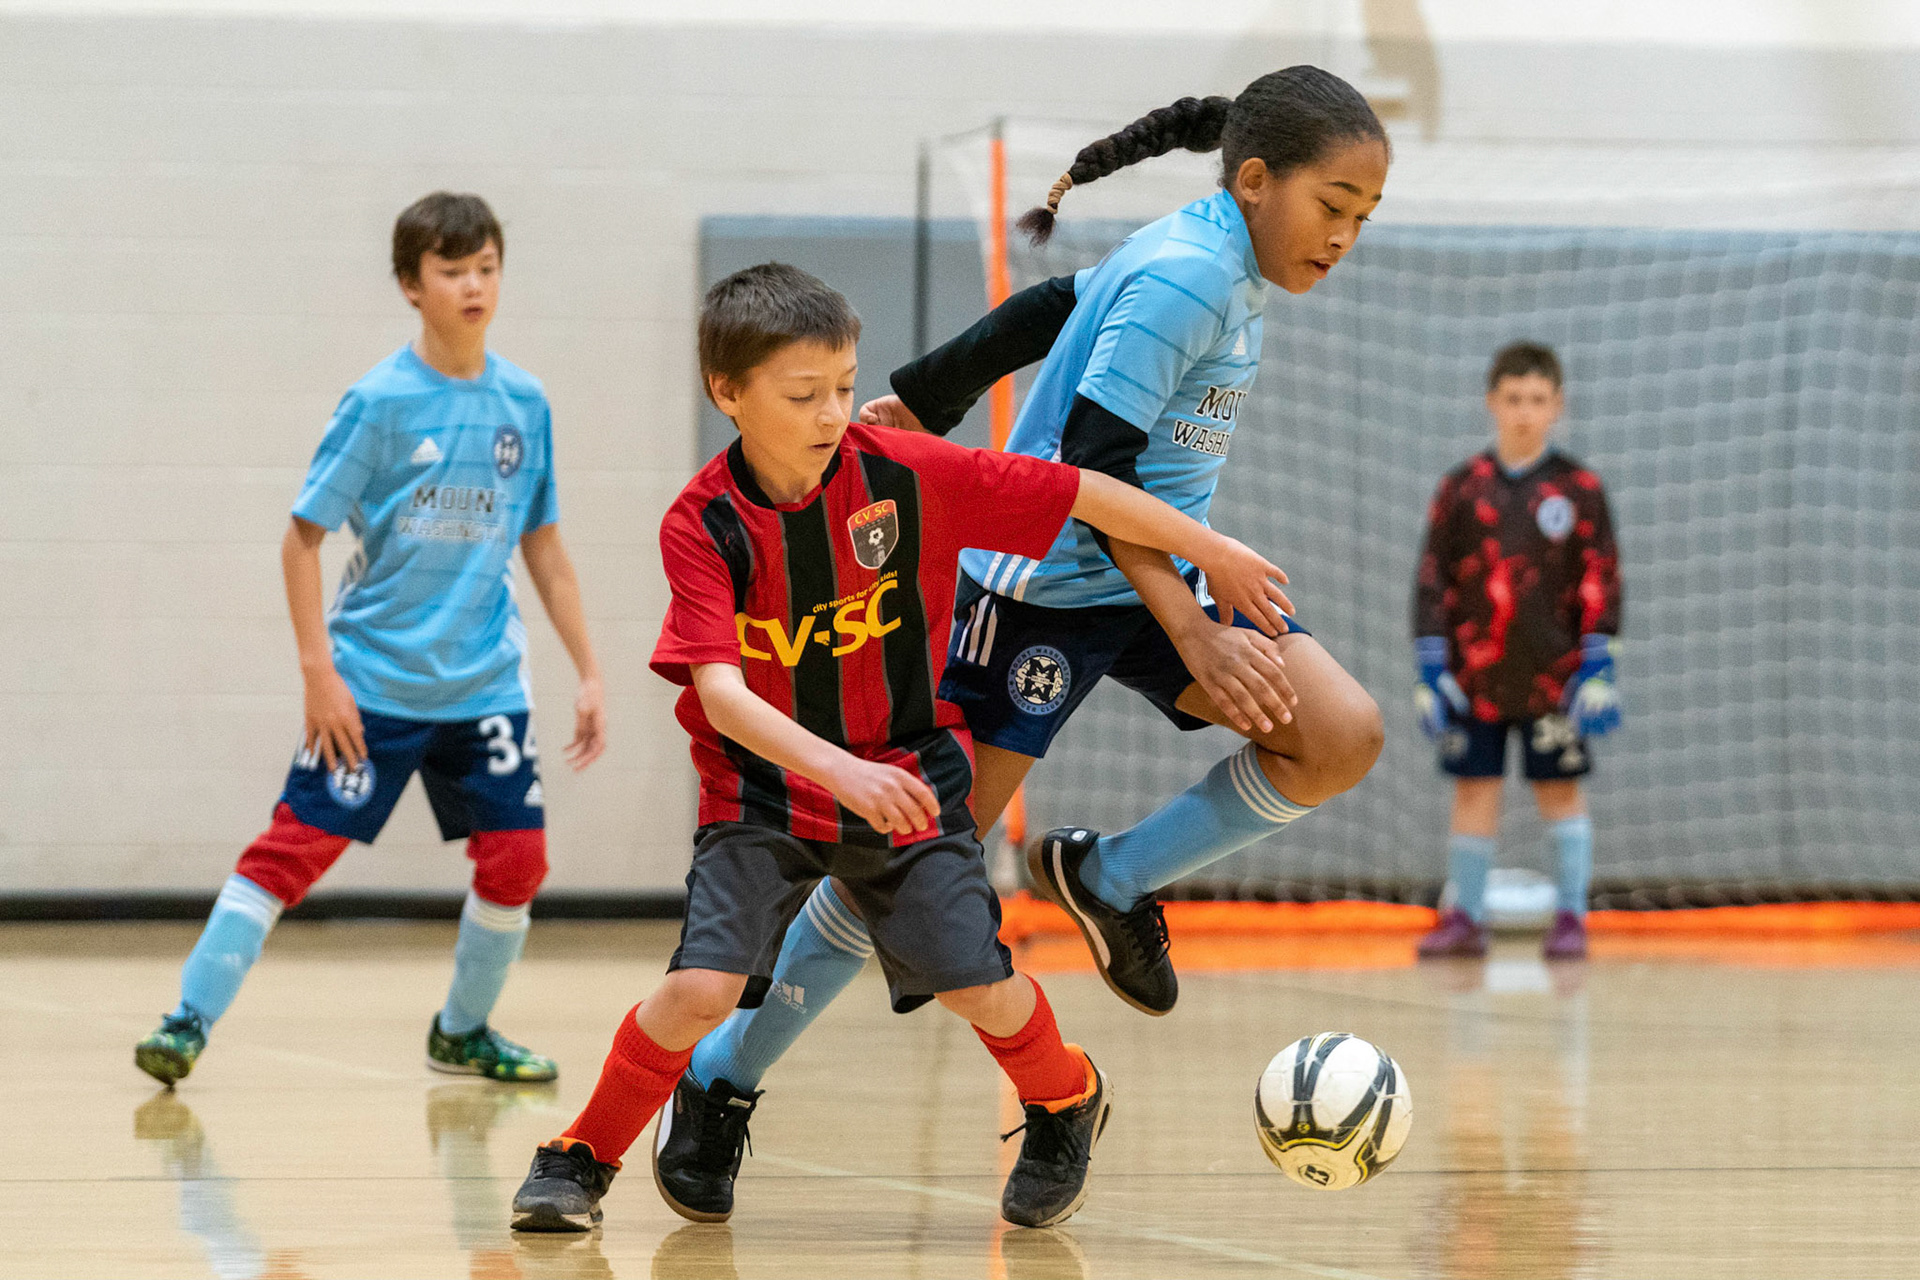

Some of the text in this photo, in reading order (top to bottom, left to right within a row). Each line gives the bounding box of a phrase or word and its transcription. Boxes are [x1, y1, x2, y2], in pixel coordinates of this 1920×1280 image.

[413, 486, 503, 513] MOUN
[854, 502, 888, 525] CV SC
[812, 602, 828, 614] city
[829, 595, 855, 607] sports
[856, 589, 869, 600] for
[869, 580, 880, 592] city
